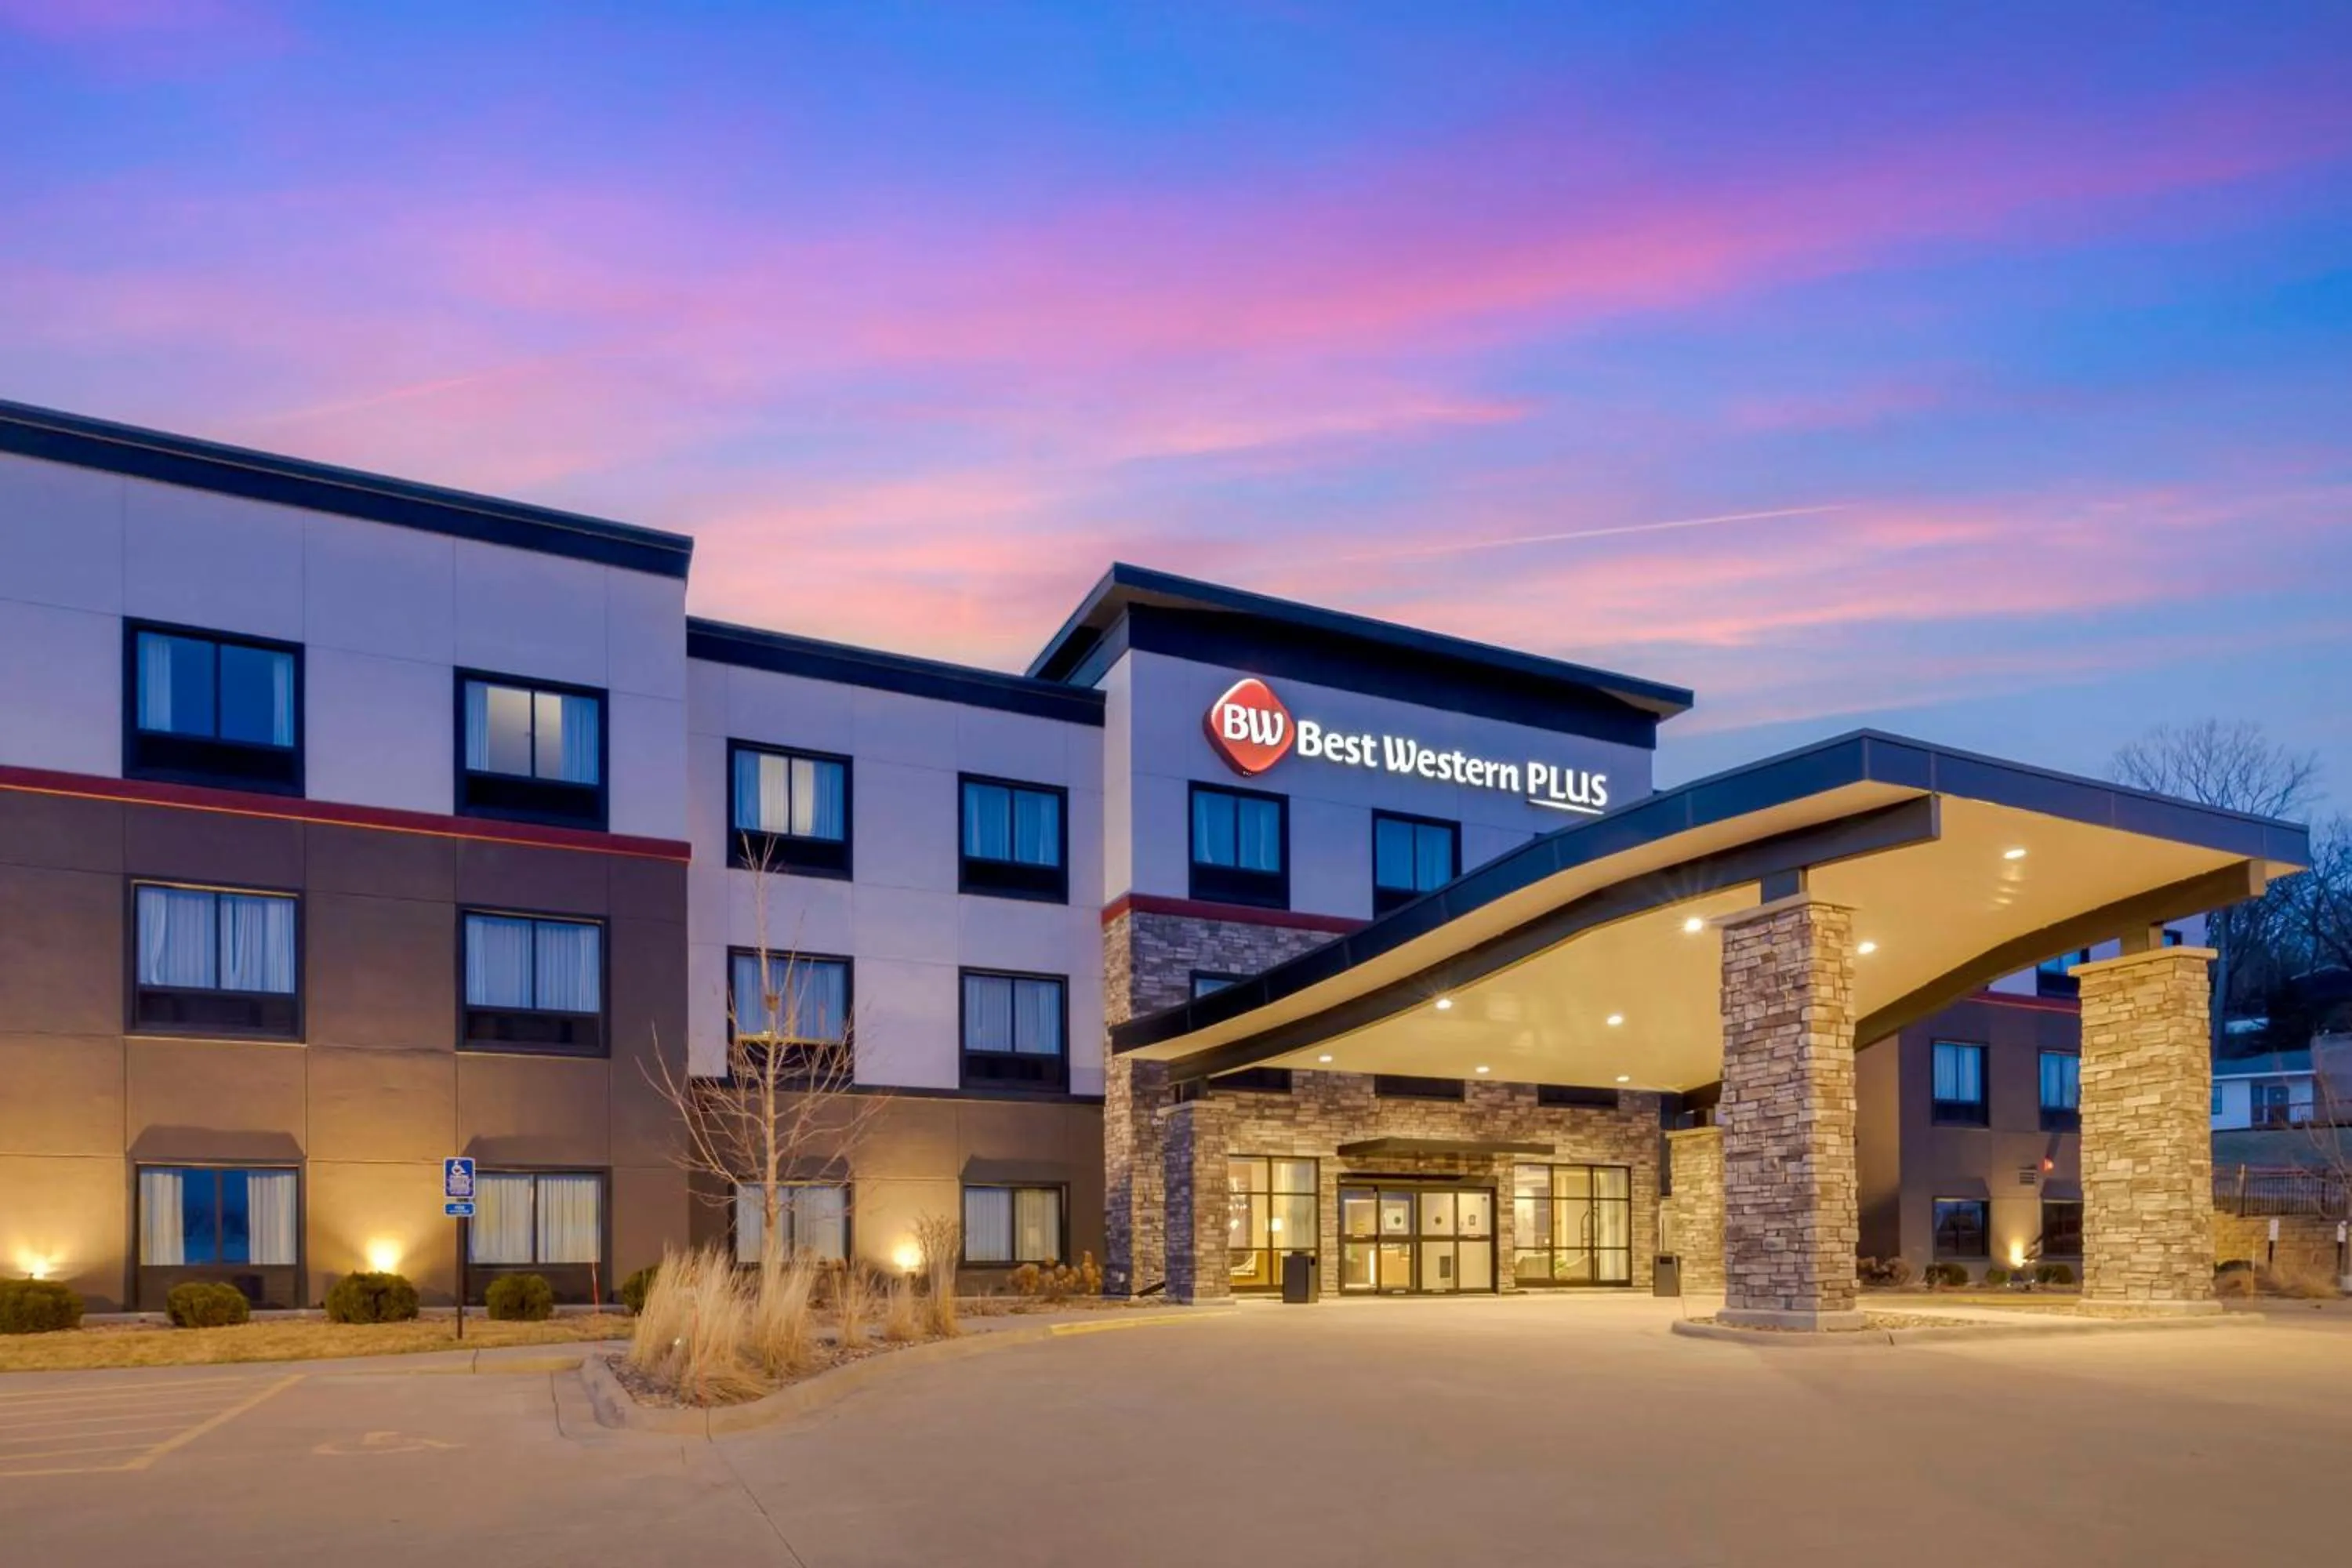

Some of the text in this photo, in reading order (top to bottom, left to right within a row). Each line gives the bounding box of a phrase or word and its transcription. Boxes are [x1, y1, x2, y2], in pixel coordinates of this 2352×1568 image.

[1223, 703, 1284, 746] BW
[1298, 720, 1607, 807] Best Western PLUS
